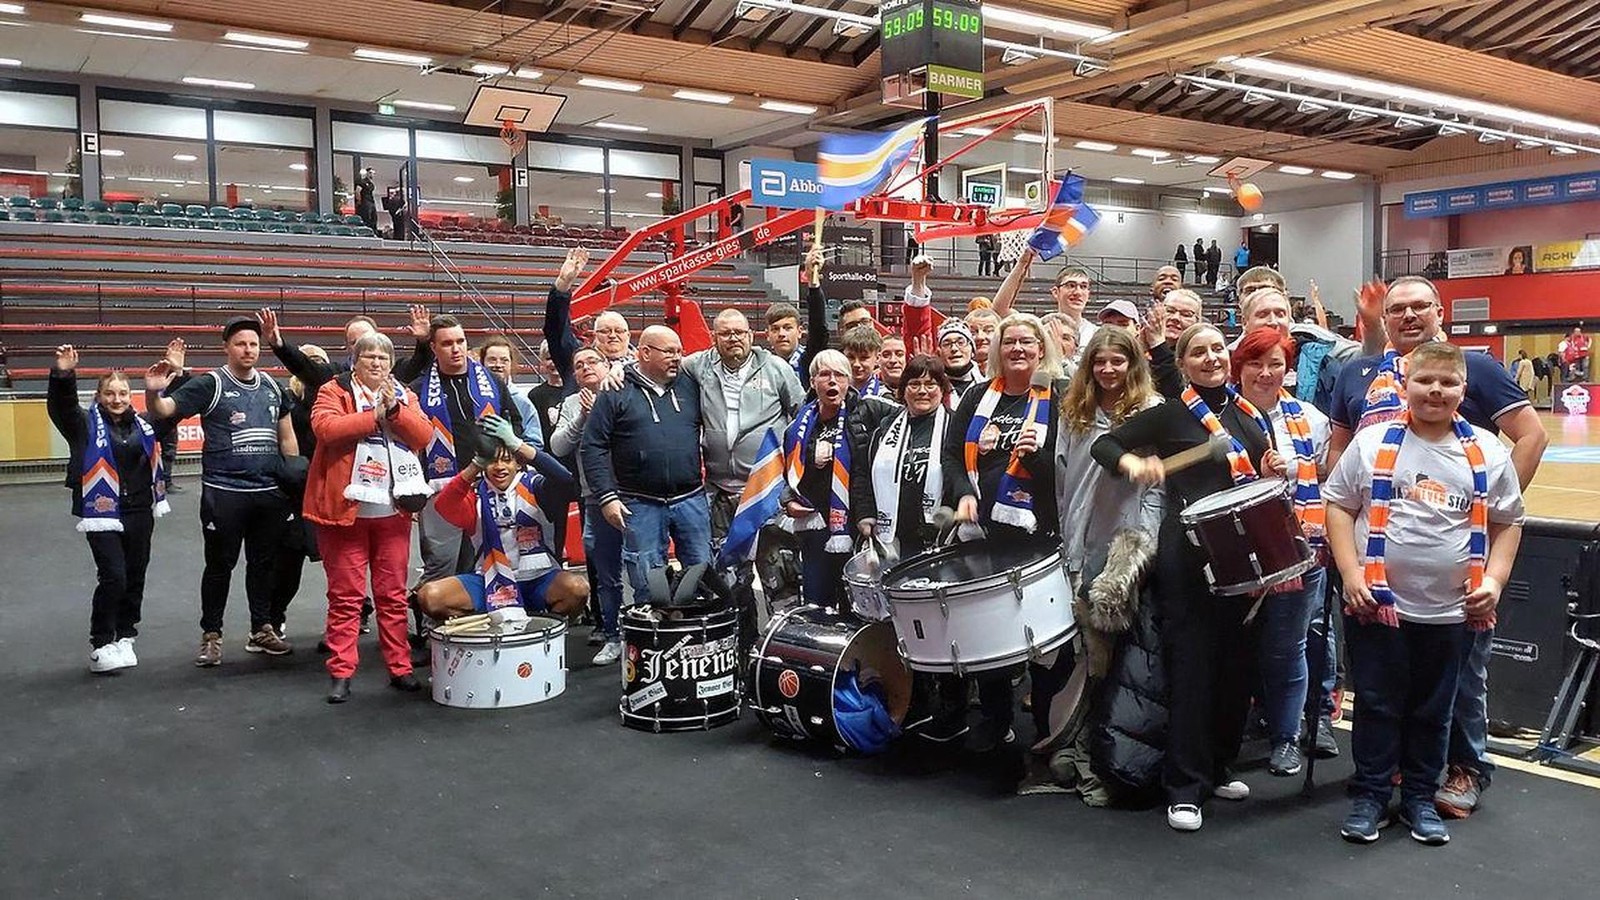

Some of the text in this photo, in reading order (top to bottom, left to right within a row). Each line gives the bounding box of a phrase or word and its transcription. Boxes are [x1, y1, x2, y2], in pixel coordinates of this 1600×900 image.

[884, 9, 924, 39] 59:09
[933, 7, 979, 34] 59:09
[929, 71, 982, 91] BARMER
[84, 134, 96, 152] E
[518, 170, 526, 186] F
[789, 178, 825, 194] Abbo
[1118, 213, 1124, 224] H
[641, 649, 738, 684] Jenens
